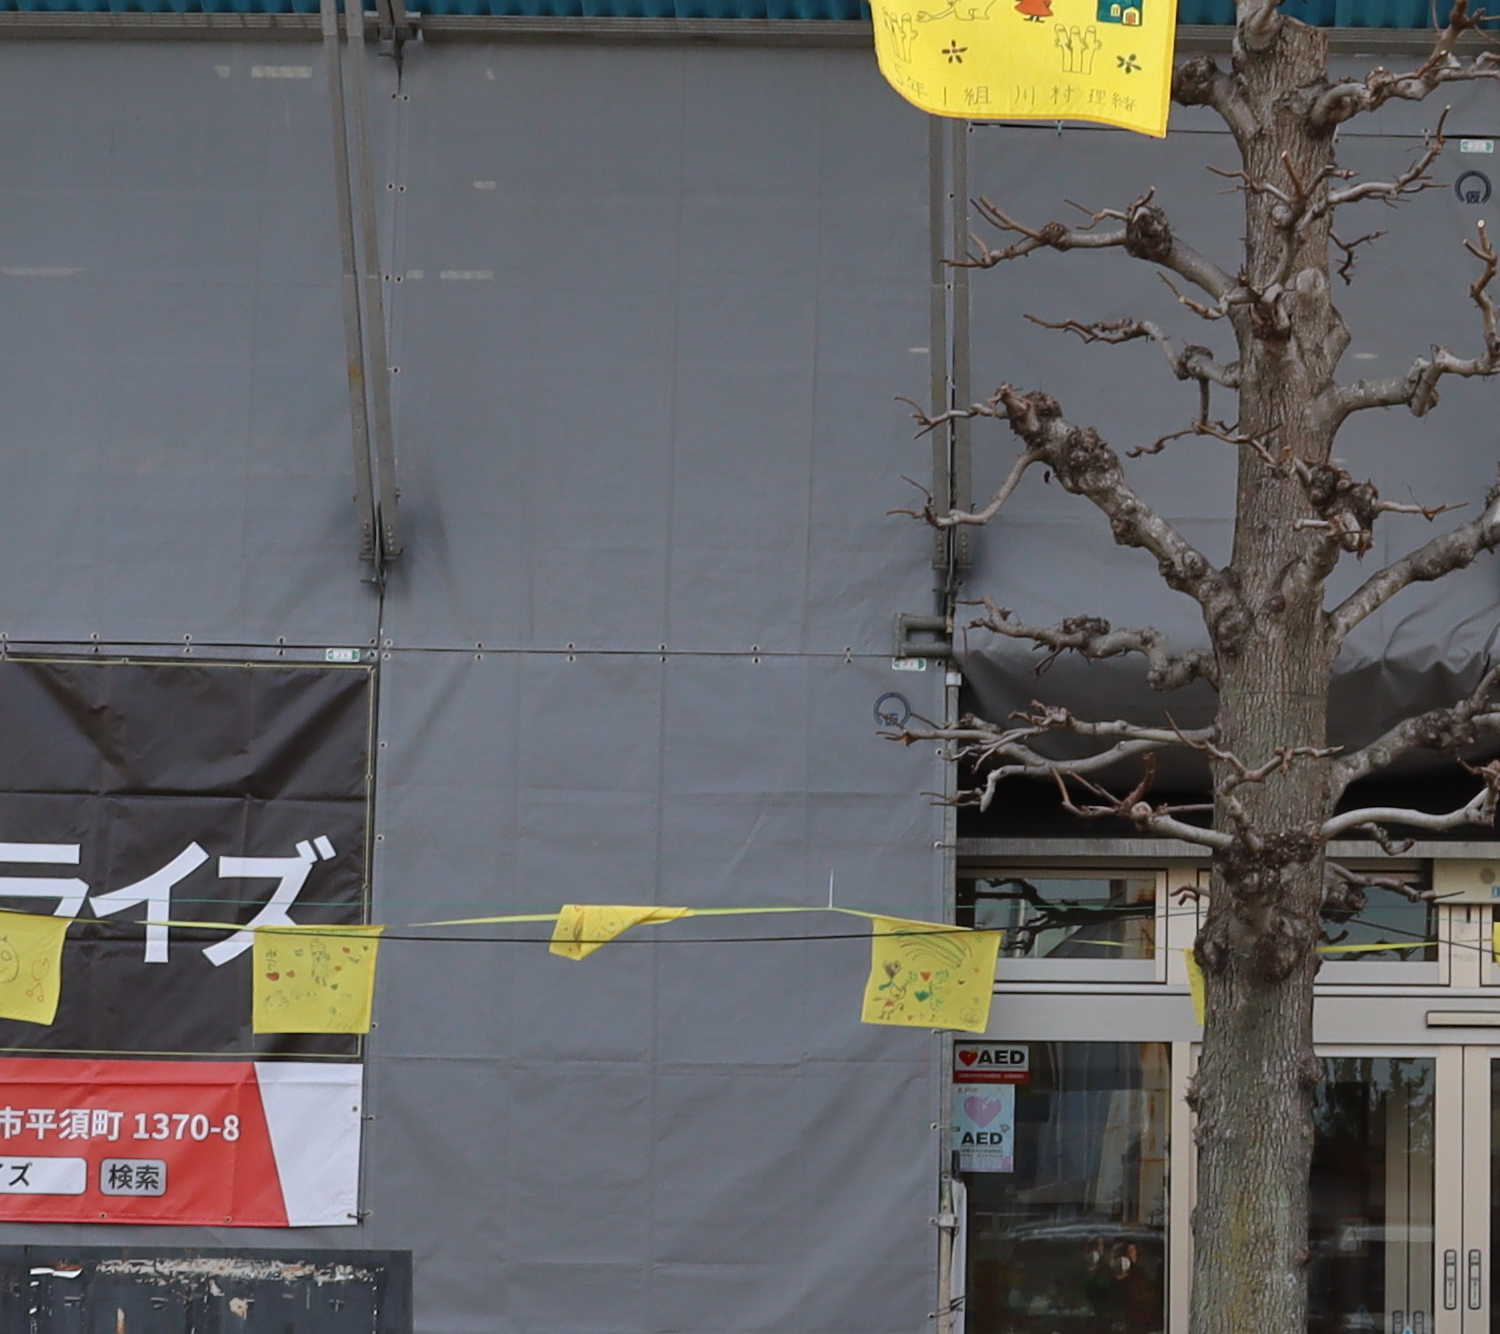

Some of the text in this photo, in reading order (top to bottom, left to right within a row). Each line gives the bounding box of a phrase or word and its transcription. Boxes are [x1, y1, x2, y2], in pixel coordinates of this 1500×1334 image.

[978, 1050, 1025, 1065] AED
[132, 1112, 240, 1142] 1370-8
[961, 1131, 1003, 1145] AED
[108, 1164, 160, 1191] 検索
